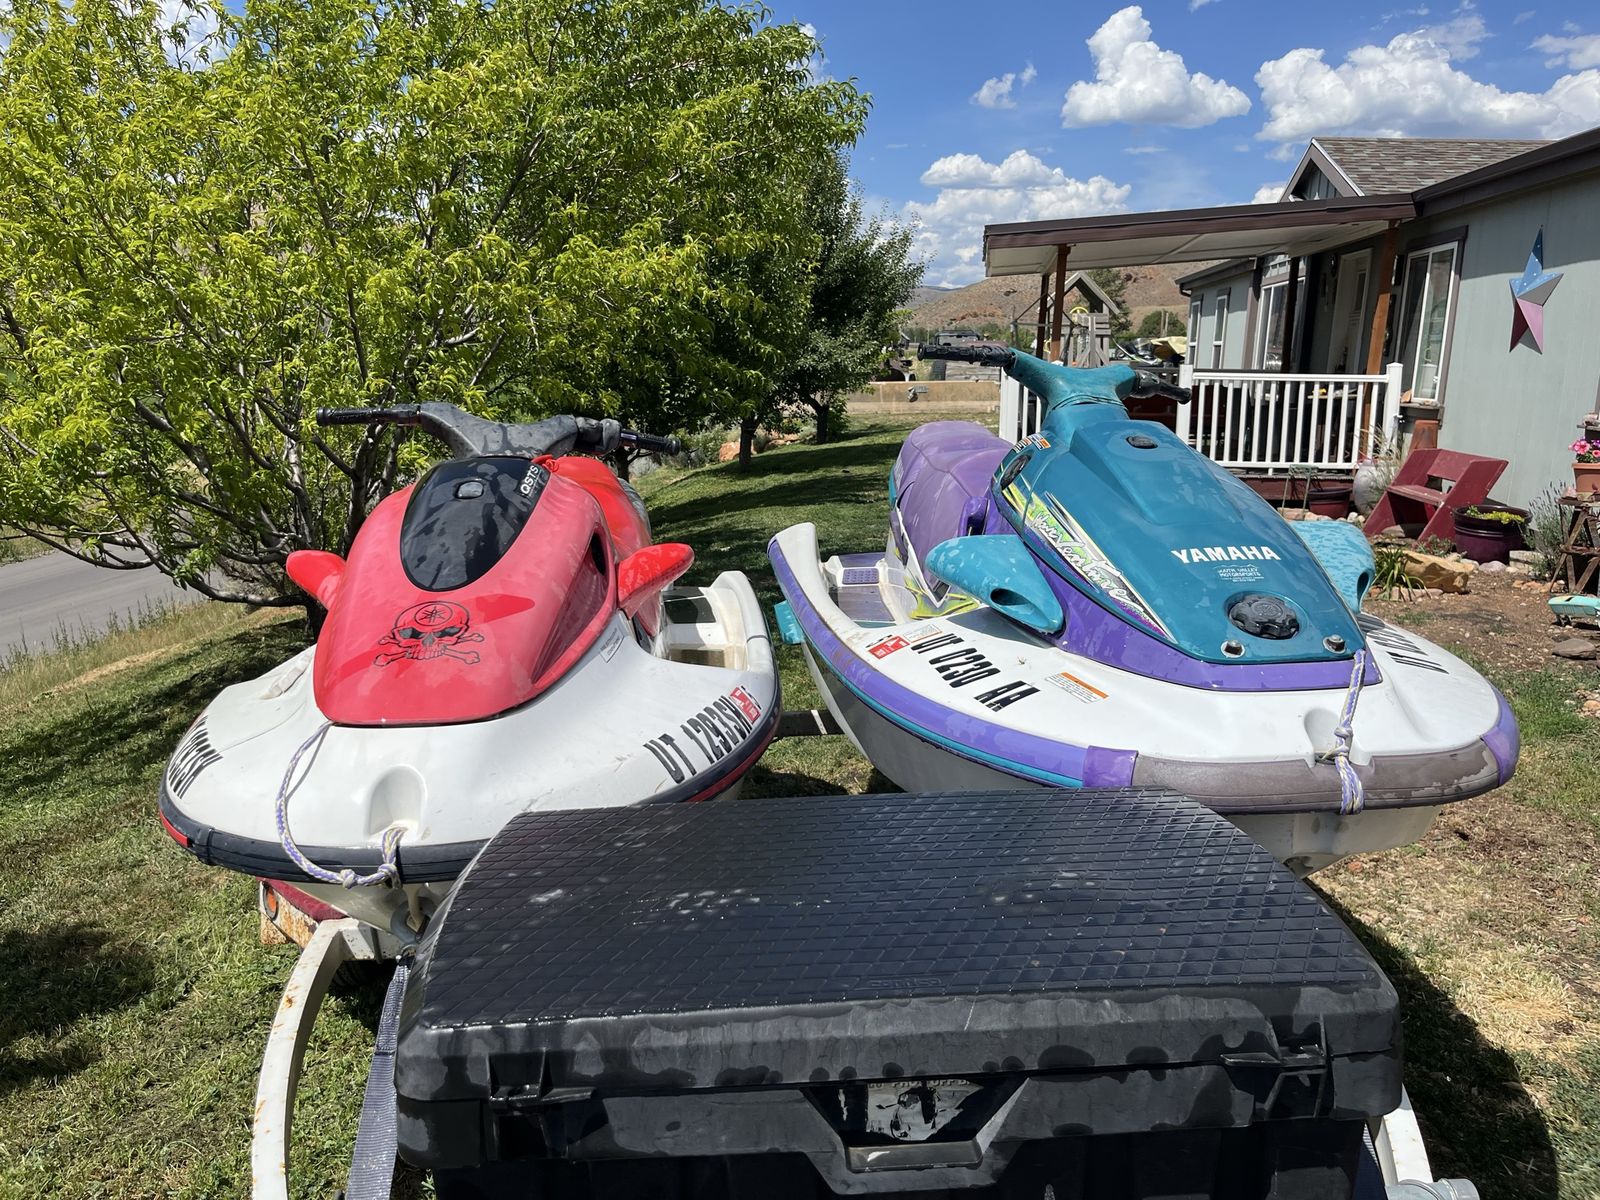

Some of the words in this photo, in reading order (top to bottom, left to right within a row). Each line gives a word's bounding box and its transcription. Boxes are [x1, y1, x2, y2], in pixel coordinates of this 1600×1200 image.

[520, 465, 539, 495] QSTS
[1171, 545, 1281, 564] YAMAHA
[910, 633, 965, 654] UT
[928, 647, 1001, 689] 0230
[974, 680, 1041, 713] AA
[642, 733, 697, 784] UT
